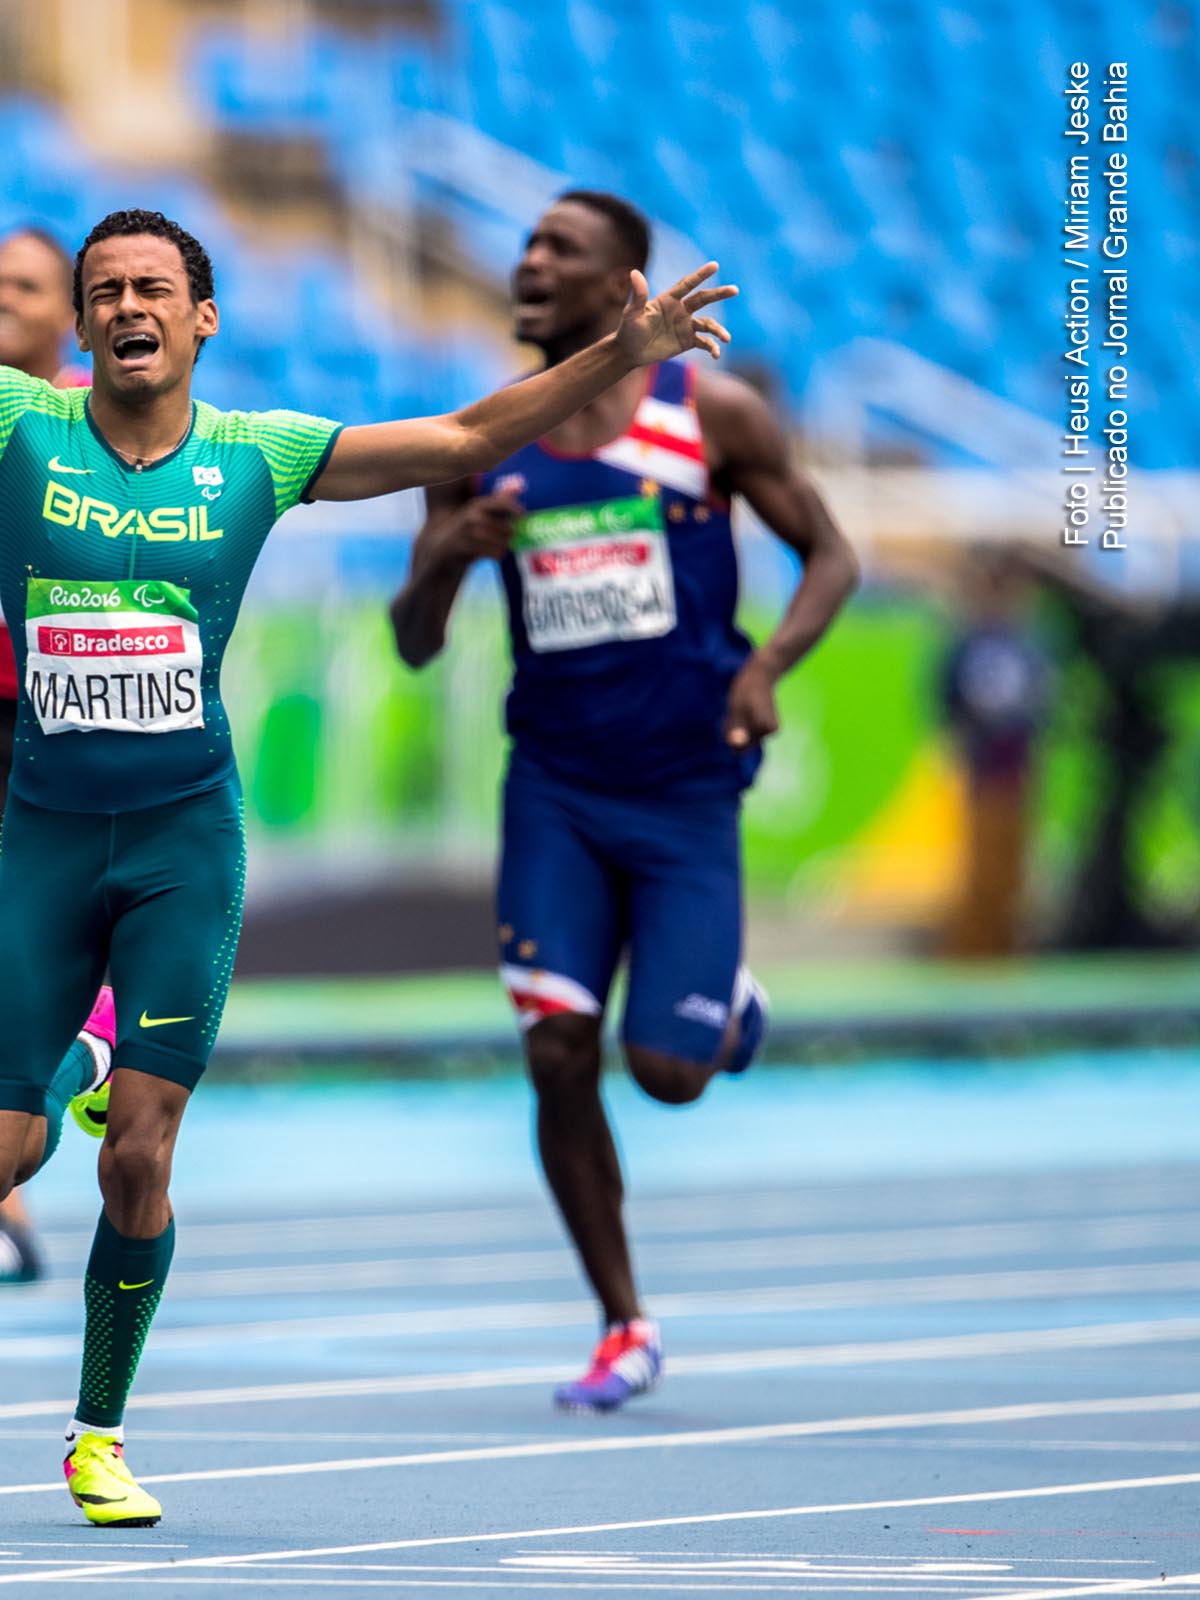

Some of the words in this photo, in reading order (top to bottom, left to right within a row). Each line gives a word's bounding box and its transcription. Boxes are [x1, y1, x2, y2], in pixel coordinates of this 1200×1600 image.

[42, 479, 224, 541] BRASIL
[50, 585, 121, 608] Rio2016
[73, 632, 169, 653] Bradesco
[31, 668, 196, 720] MARTINS
